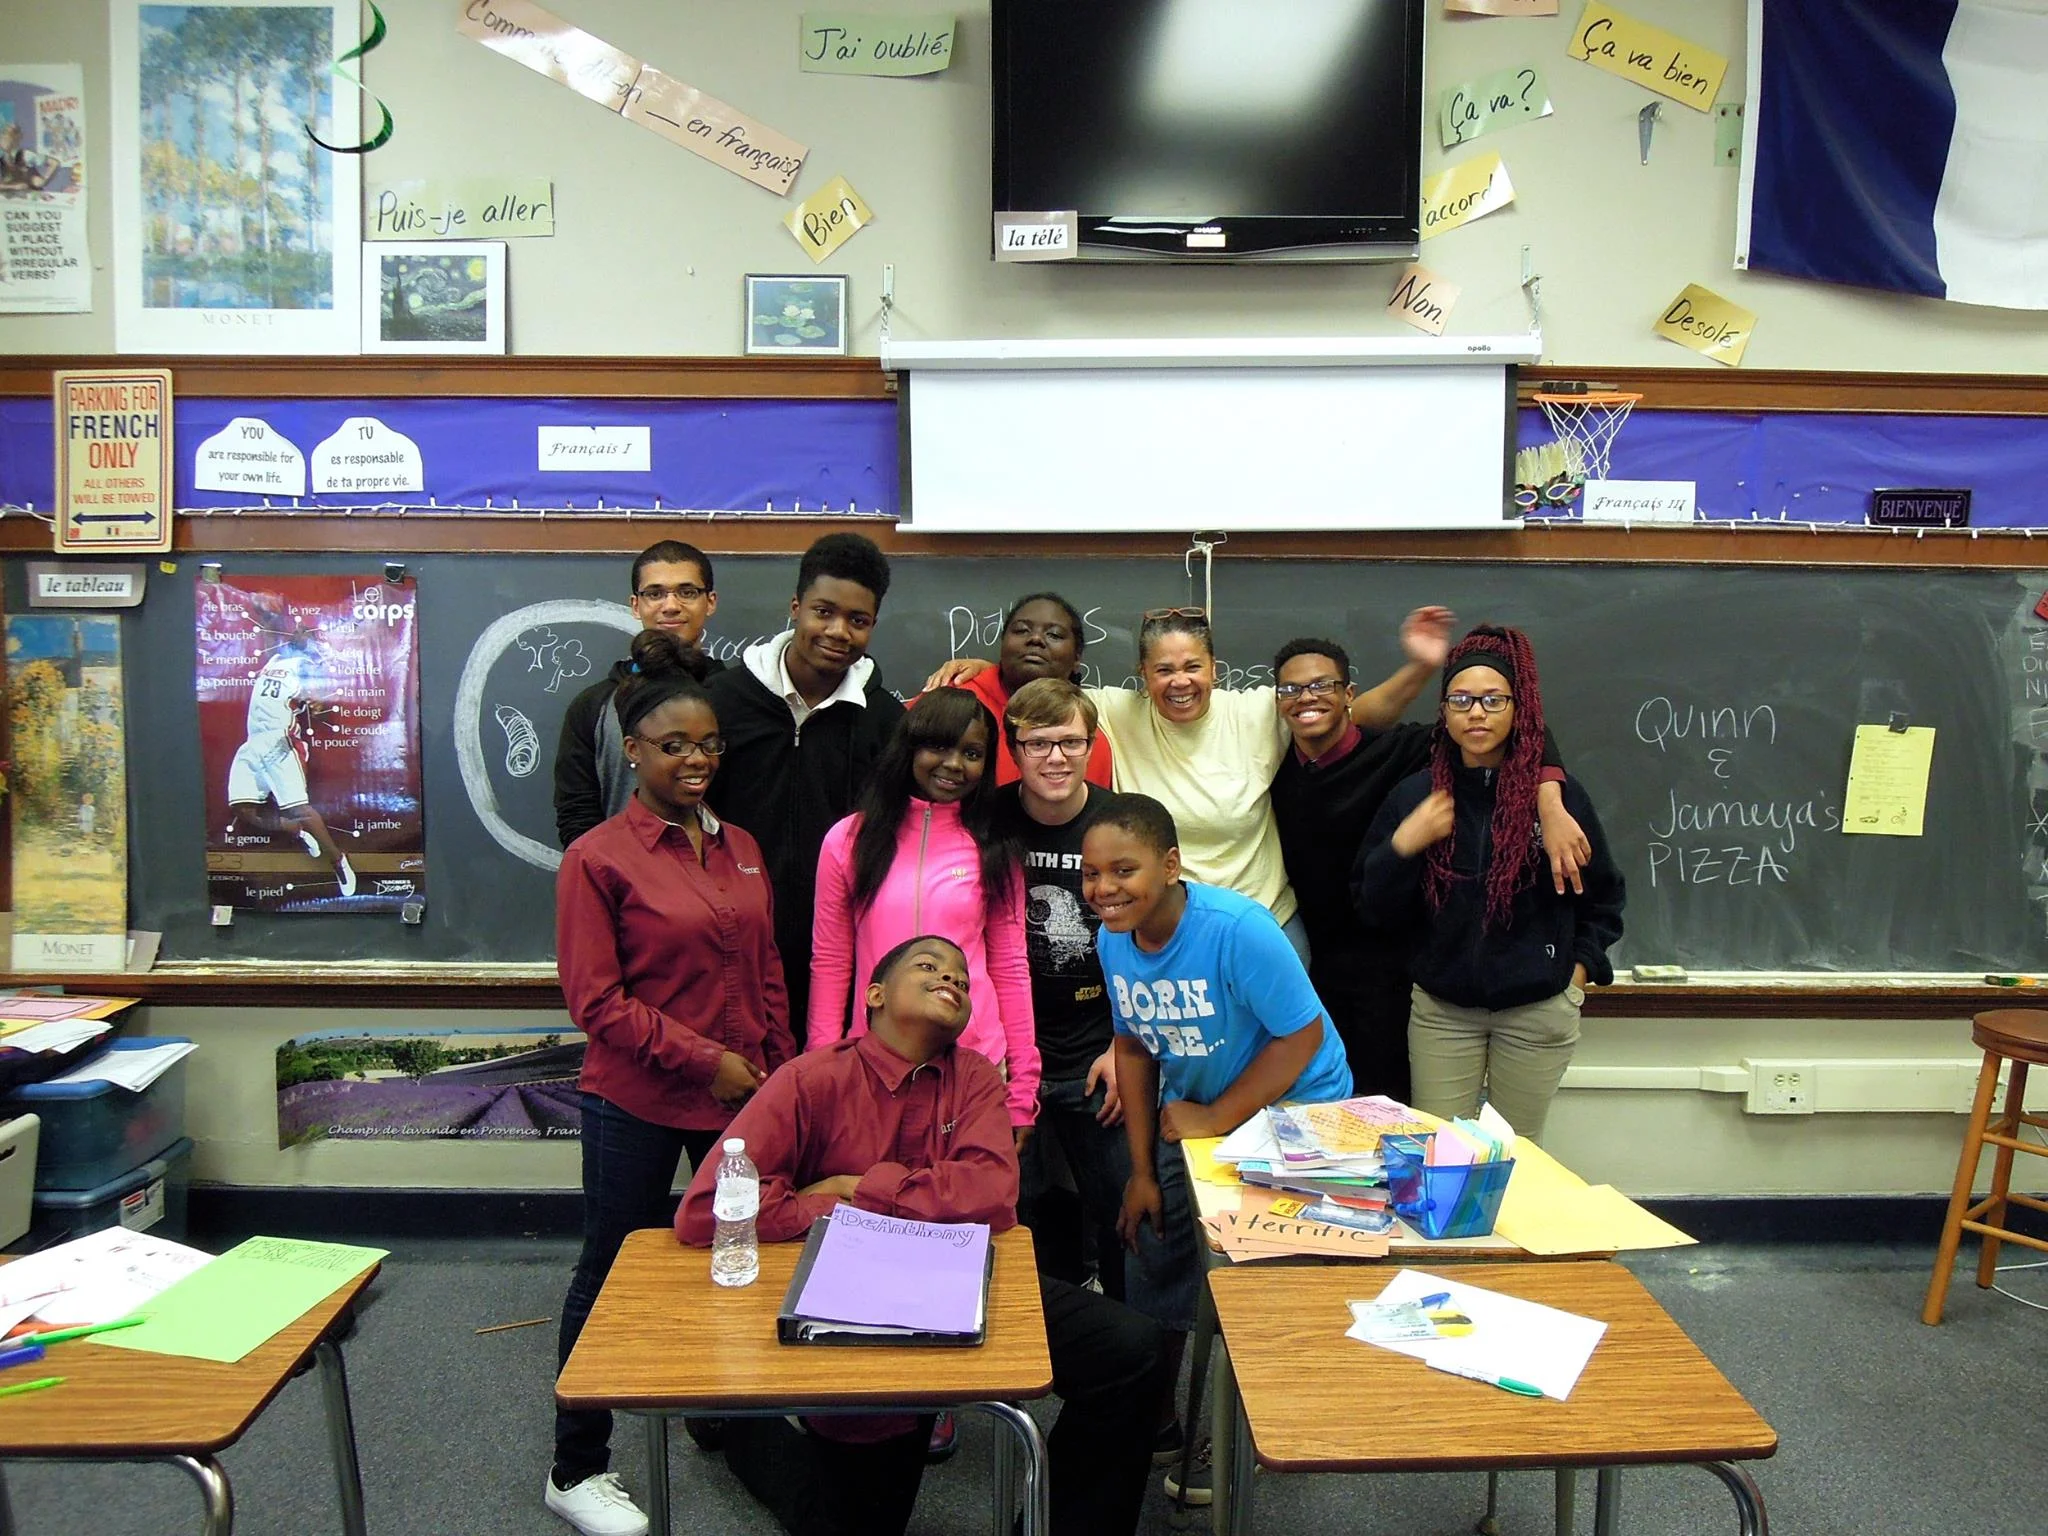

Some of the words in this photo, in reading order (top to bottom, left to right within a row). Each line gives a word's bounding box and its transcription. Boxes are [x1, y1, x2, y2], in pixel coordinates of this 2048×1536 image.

[805, 28, 862, 60] J'ai
[873, 32, 949, 60] oublié.
[1582, 18, 1616, 62] Ça
[1628, 49, 1654, 71] va
[1663, 52, 1711, 95] bien
[1450, 92, 1480, 143] Ça
[686, 117, 713, 138] en
[716, 126, 802, 184] français?
[5, 212, 30, 221] CAN
[35, 211, 62, 221] YOU
[377, 190, 466, 236] Puis-je
[482, 194, 548, 223] aller
[6, 223, 62, 233] SUGGEST
[802, 196, 858, 247] Bien
[8, 235, 17, 244] A
[21, 235, 61, 244] PLACE
[1008, 229, 1025, 247] la
[1031, 228, 1063, 245] télé
[9, 246, 64, 257] WITHOUT
[10, 258, 78, 269] IRREGULAR
[11, 270, 56, 281] VERBS?
[202, 313, 275, 326] MONET
[70, 386, 128, 411] PARKING
[132, 386, 158, 410] FOR
[70, 414, 159, 440] FRENCH
[241, 426, 265, 440] YOU
[357, 426, 375, 440] TU
[89, 442, 139, 469] ONLY
[208, 449, 225, 460] are
[226, 451, 278, 464] responsible
[280, 452, 295, 463] for
[548, 442, 618, 457] Français
[622, 443, 633, 454] I
[331, 455, 342, 465] es
[344, 451, 405, 467] responsable
[83, 478, 102, 489] ALL
[105, 478, 145, 489] OTHERS
[218, 471, 240, 484] your
[242, 473, 263, 483] own
[326, 476, 338, 488] de
[341, 476, 353, 488] ta
[355, 477, 390, 492] propre
[73, 493, 99, 505] WILL
[102, 493, 115, 504] BE
[118, 492, 155, 504] TOWED
[1592, 495, 1664, 512] Français
[1880, 497, 1962, 520] BIENVENUE
[47, 577, 62, 592] le
[66, 577, 125, 593] tableau
[352, 580, 381, 603] Le
[288, 604, 298, 615] le
[301, 606, 321, 615] nez
[353, 604, 415, 627] corps
[214, 630, 256, 640] bouche
[203, 654, 213, 664] le
[216, 655, 258, 665] menton
[213, 676, 256, 690] poitrine
[261, 679, 281, 698] 23
[344, 687, 354, 697] la
[357, 687, 385, 697] main
[340, 707, 350, 717] le
[353, 707, 382, 719] doigt
[341, 726, 352, 735] le
[354, 725, 389, 735] coude
[1634, 697, 1777, 752] Quinn
[311, 737, 322, 747] le
[354, 819, 364, 829] la
[367, 819, 402, 832] jambe
[224, 833, 234, 844] le
[237, 835, 270, 845] genou
[1025, 851, 1058, 868] ATH
[1061, 852, 1083, 869] ST
[1647, 842, 1789, 888] PIZZA
[246, 887, 256, 896] le
[259, 886, 284, 899] pied
[42, 939, 95, 955] MONET
[1113, 974, 1216, 1022] BORN
[328, 1124, 381, 1137] Champs
[383, 1125, 399, 1136] de
[402, 1125, 459, 1136] lavande
[460, 1127, 479, 1136] en
[481, 1126, 542, 1137] Provence,
[546, 1126, 582, 1137] Fran
[841, 1209, 975, 1249] DeAnthony
